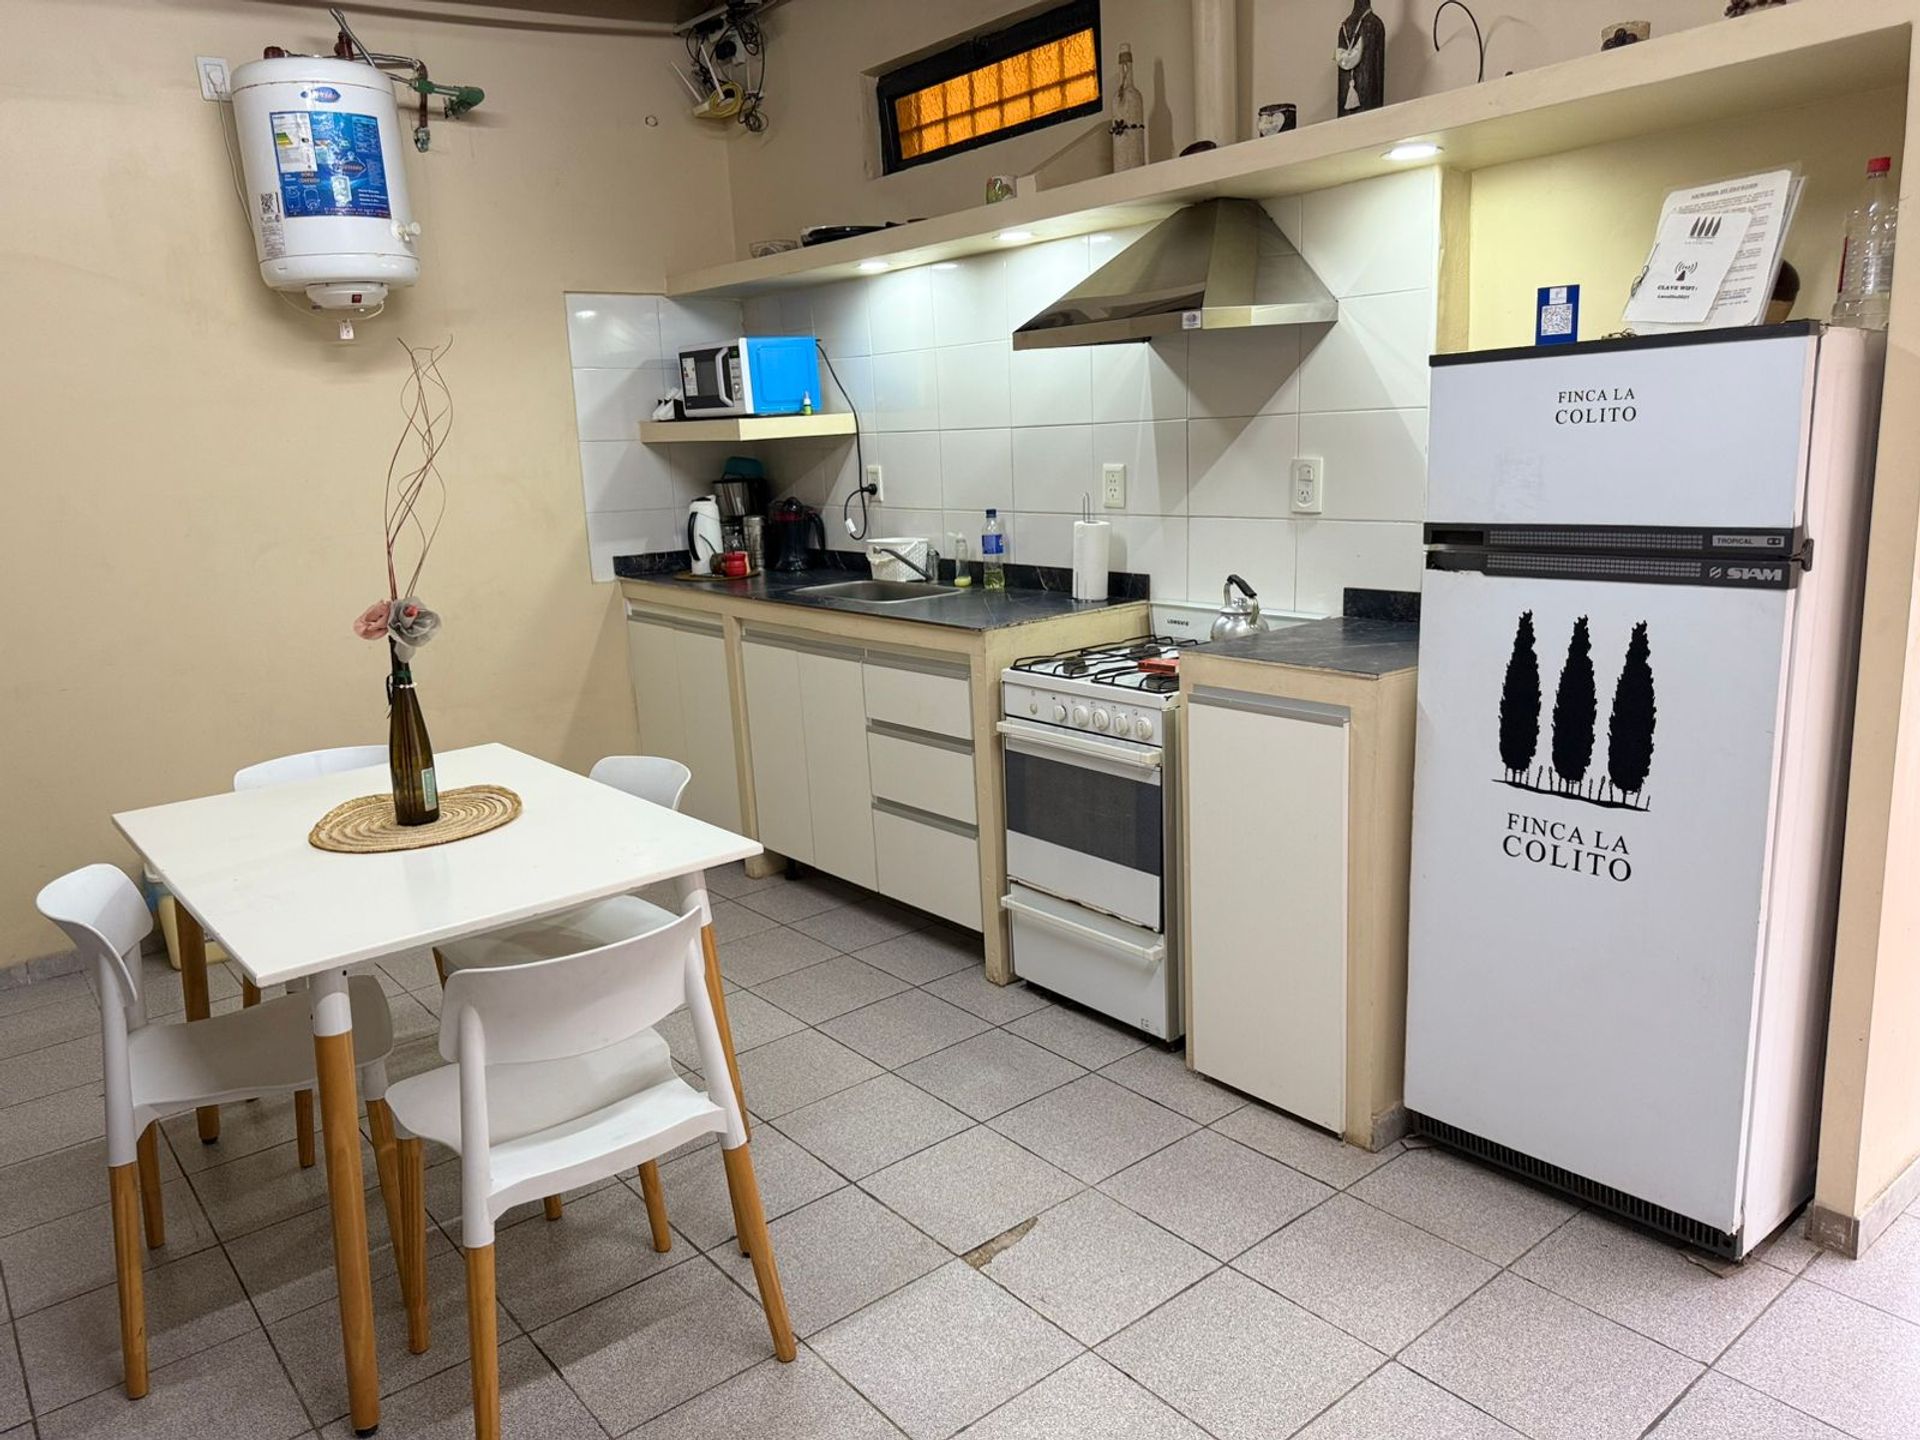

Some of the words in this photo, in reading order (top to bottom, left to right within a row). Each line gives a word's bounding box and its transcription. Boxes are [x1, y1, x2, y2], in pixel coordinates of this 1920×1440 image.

[1558, 389, 1608, 404] FINCA
[1613, 387, 1635, 401] LA
[1555, 406, 1637, 425] COLITO
[1716, 537, 1753, 545] TROPICAL
[1726, 567, 1782, 582] SIAM
[1507, 812, 1585, 845] FINCA
[1594, 830, 1630, 855] LA
[1502, 834, 1632, 882] COLITO
